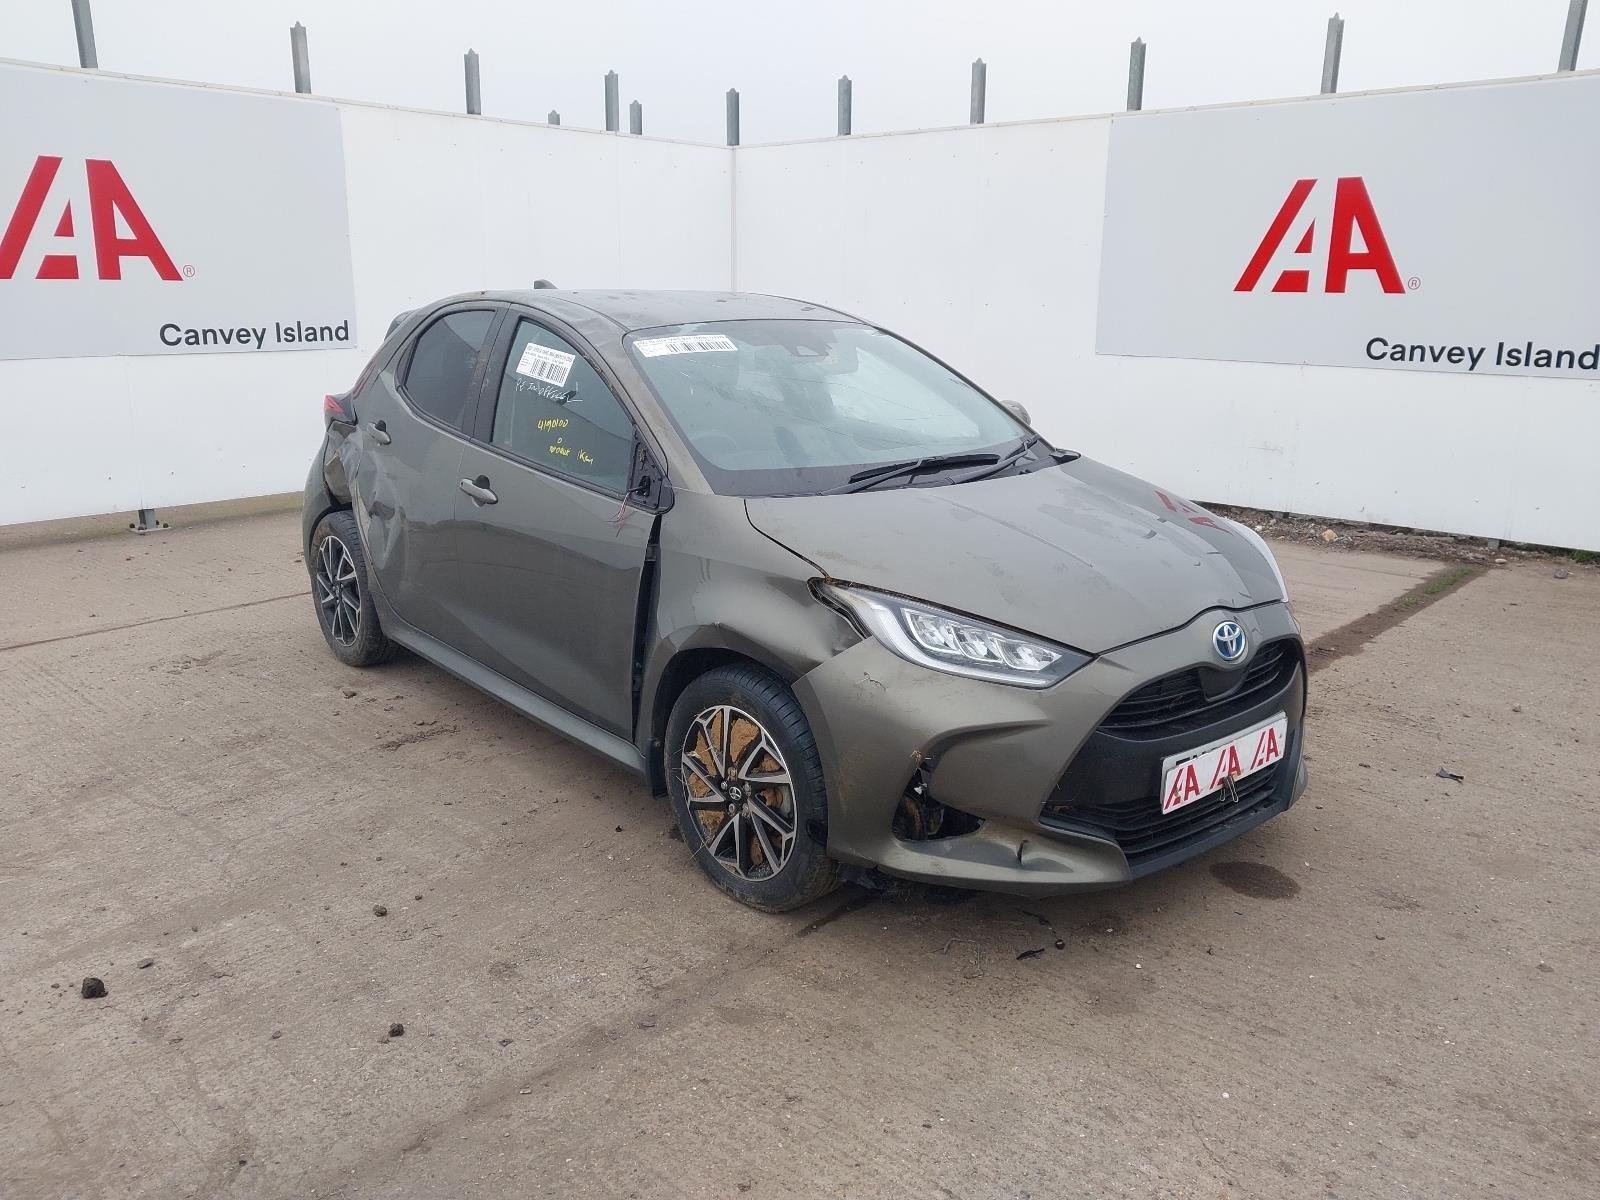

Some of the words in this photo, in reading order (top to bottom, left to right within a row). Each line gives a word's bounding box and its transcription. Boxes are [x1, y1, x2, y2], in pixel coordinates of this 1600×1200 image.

[159, 323, 267, 349] Canvey
[275, 320, 350, 343] Island
[1366, 337, 1486, 371] Canvey
[1496, 342, 1600, 370] Island
